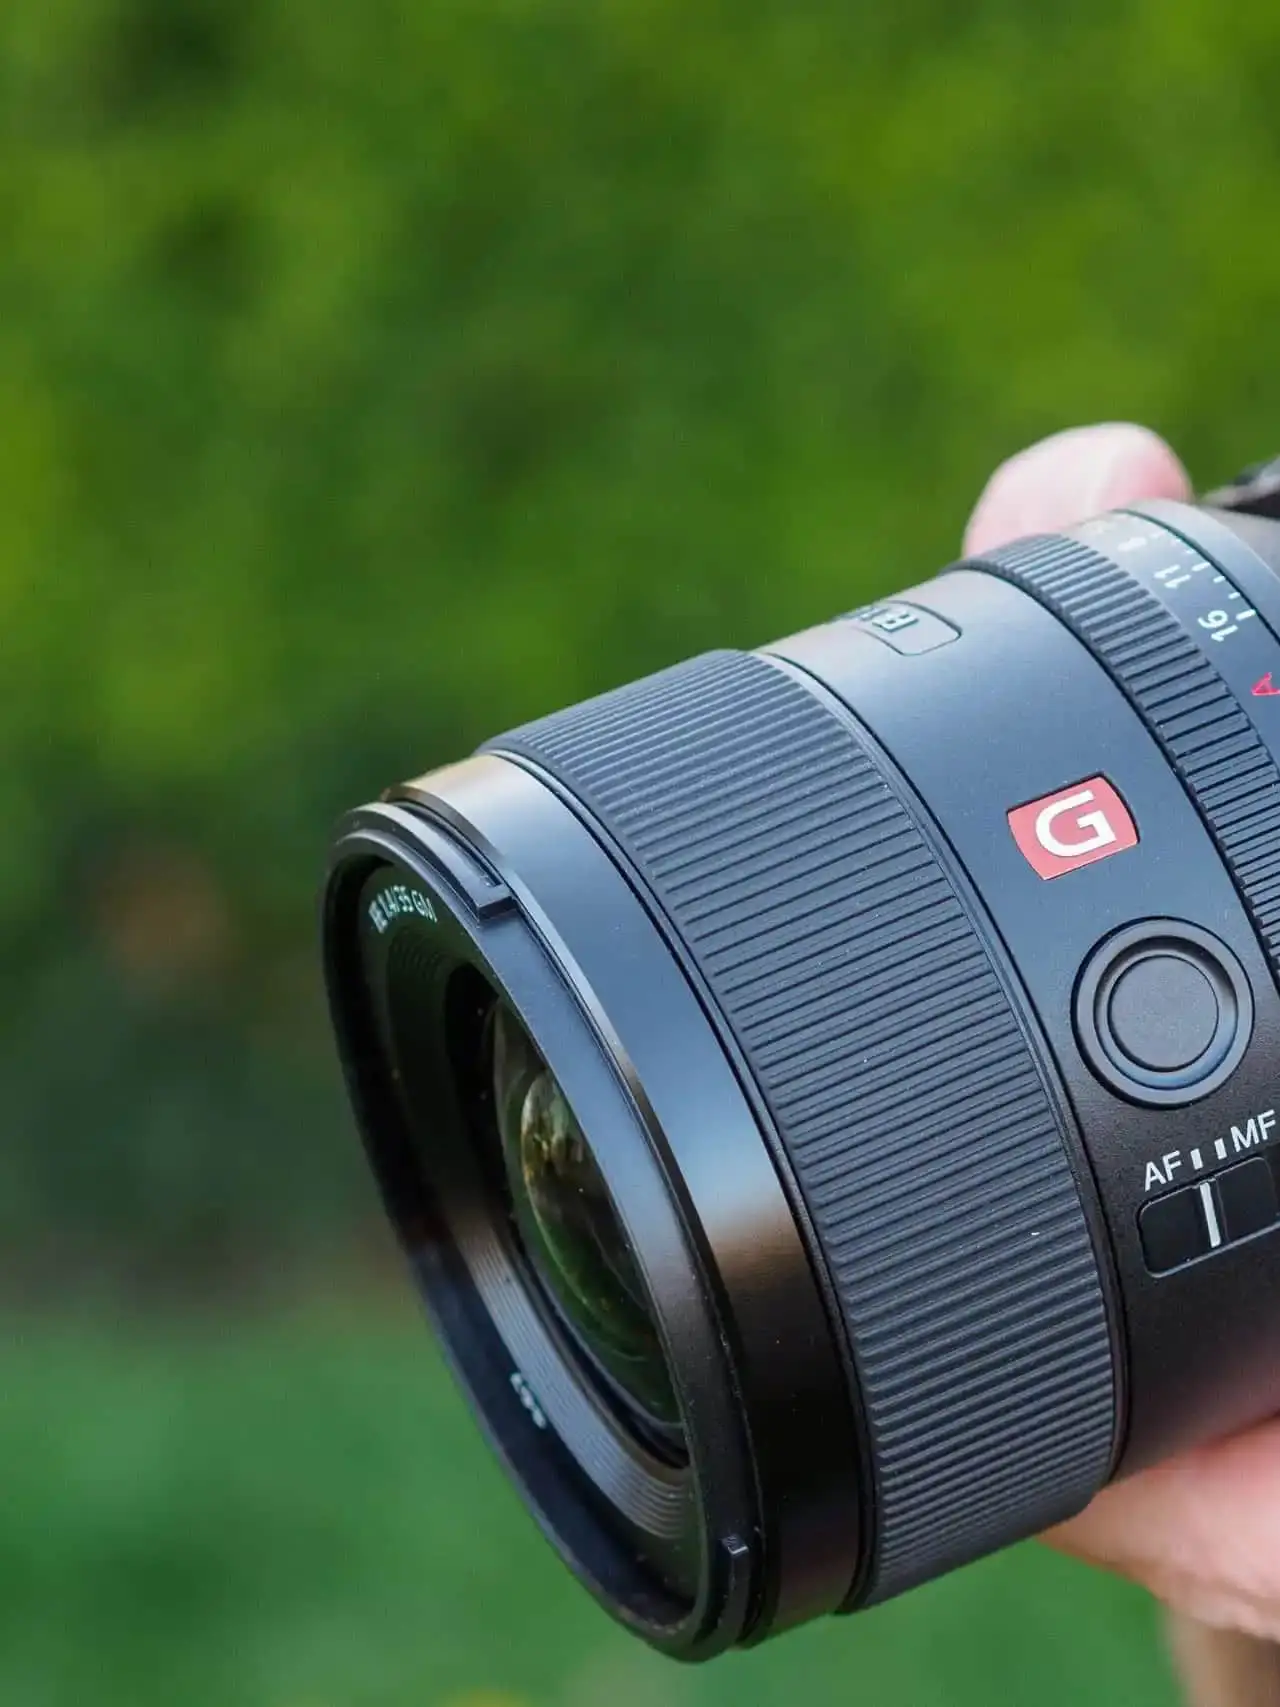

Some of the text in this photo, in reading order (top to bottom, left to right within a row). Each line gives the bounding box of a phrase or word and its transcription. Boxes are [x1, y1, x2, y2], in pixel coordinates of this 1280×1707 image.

[1153, 564, 1192, 589] 11
[1198, 610, 1238, 643] 16
[1035, 790, 1118, 857] G
[1144, 1109, 1276, 1192] AF MF
